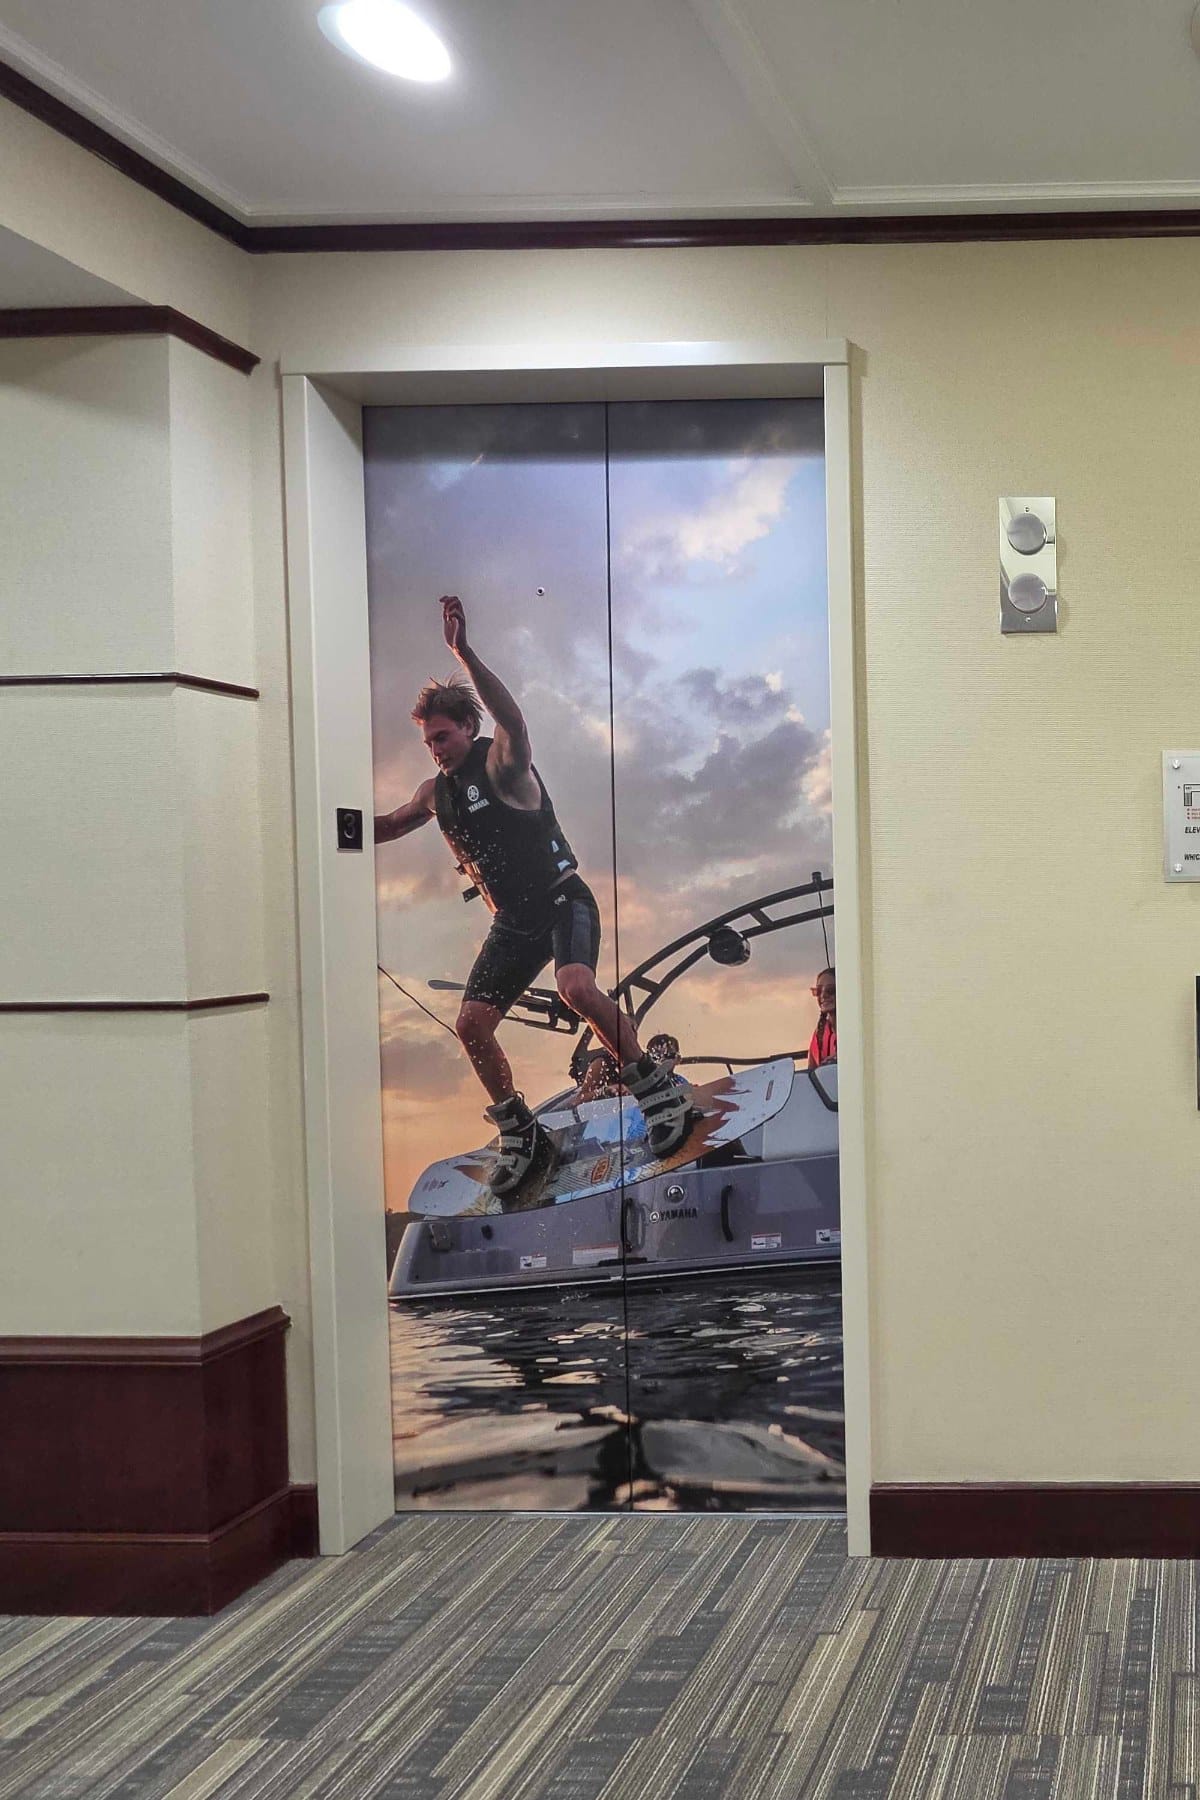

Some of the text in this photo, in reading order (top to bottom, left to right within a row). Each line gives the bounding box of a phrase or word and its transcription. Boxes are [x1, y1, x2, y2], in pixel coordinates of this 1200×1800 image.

[467, 798, 490, 813] YAMAHA
[343, 813, 356, 839] 3
[660, 1208, 698, 1221] YAMAHA
